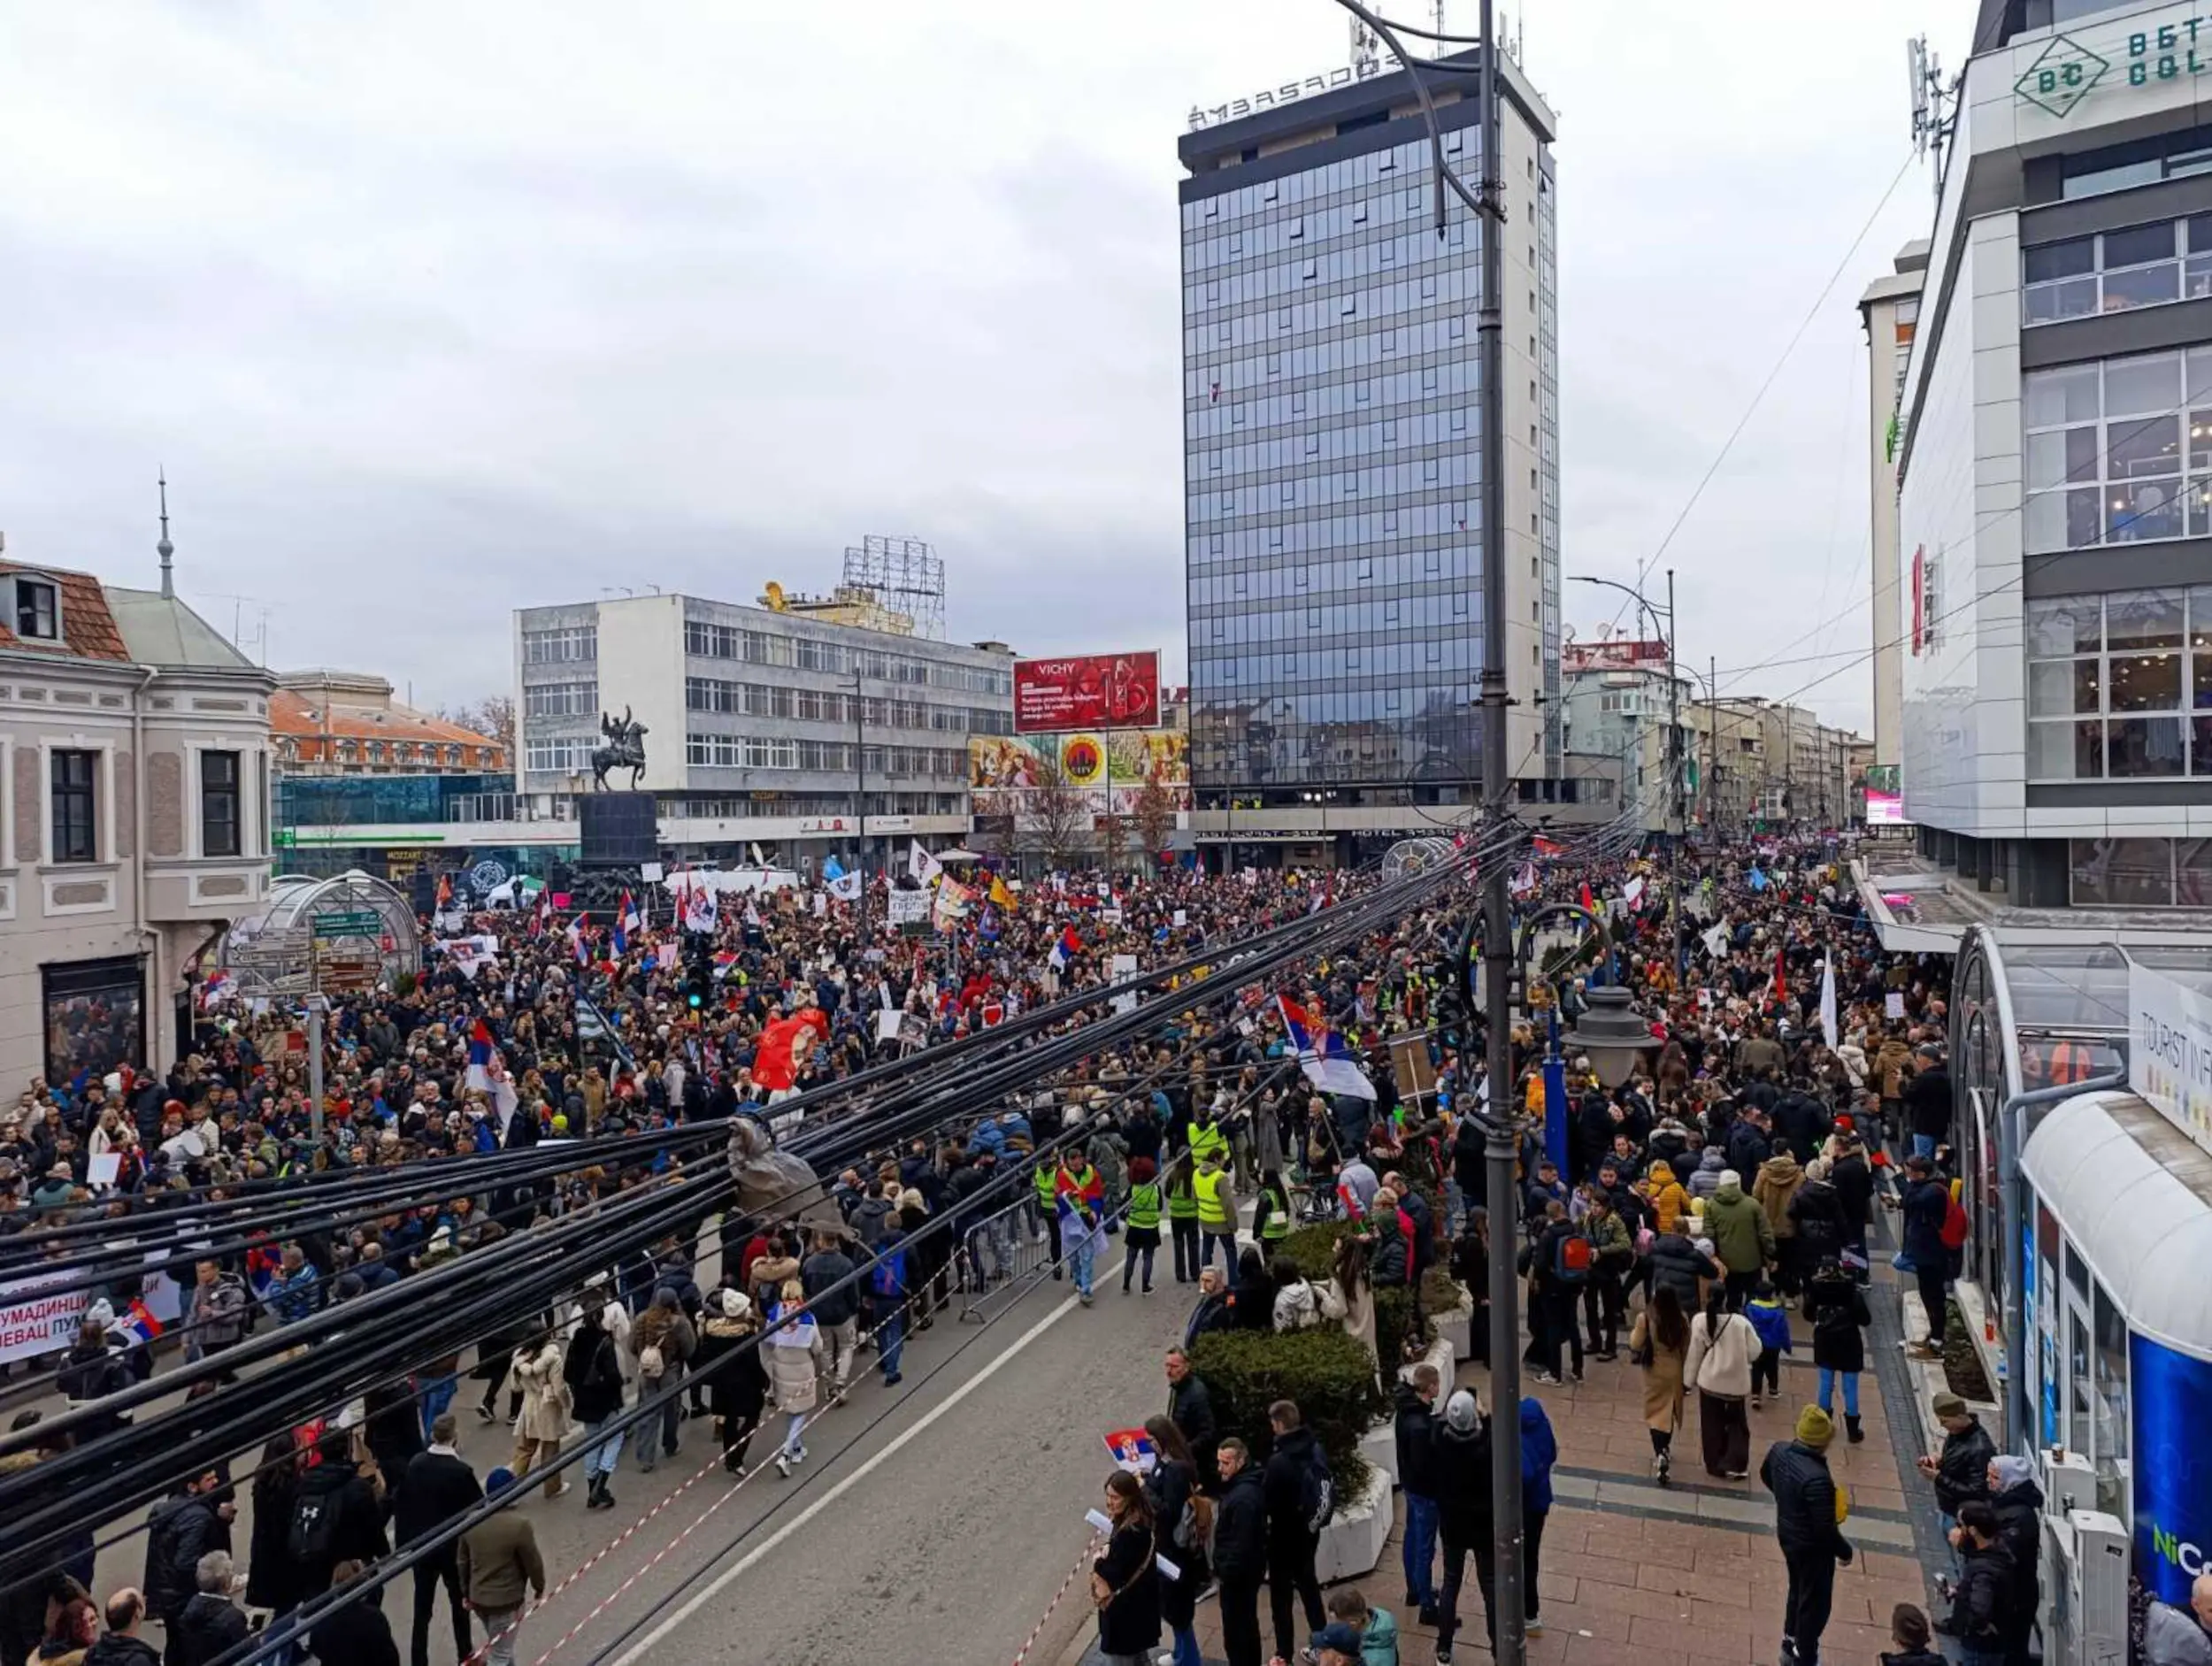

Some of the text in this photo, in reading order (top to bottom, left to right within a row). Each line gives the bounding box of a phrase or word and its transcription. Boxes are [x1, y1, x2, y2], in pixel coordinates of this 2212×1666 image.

[2129, 14, 2212, 58] BET
[1038, 663, 1077, 675] VICHY
[1351, 828, 1402, 838] HOTEL
[387, 851, 423, 861] MOZZART
[2191, 1040, 2212, 1087] INF
[0, 1294, 88, 1328] УМАДИНЦИ
[0, 1312, 87, 1348] ЕВАЦ ПУМ
